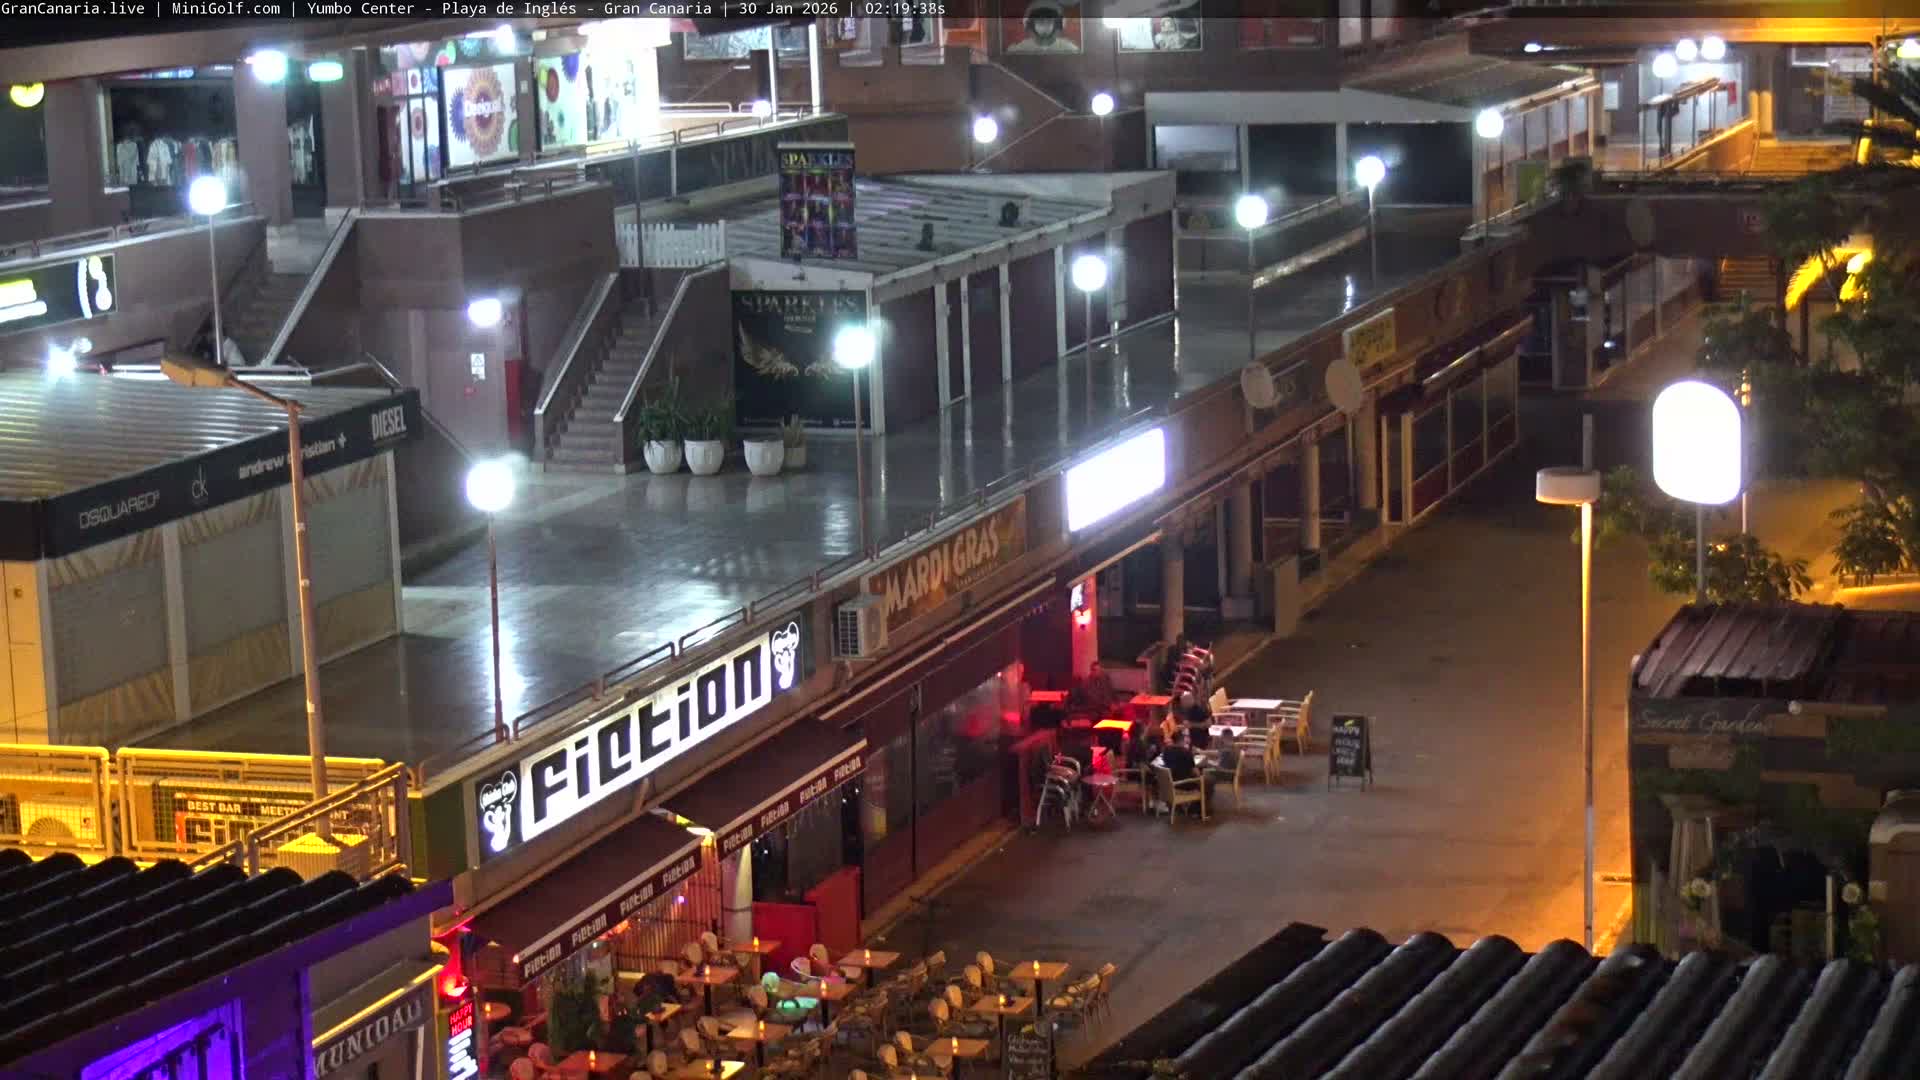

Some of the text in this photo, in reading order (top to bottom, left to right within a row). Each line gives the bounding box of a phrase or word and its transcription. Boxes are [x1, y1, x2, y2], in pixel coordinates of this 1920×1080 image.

[371, 405, 407, 440] DIESEL
[881, 543, 950, 617] MARDI
[952, 514, 1001, 577] GRAS
[187, 801, 216, 812] BEST
[218, 804, 241, 814] BAR
[450, 1002, 473, 1025] HAPPY
[451, 1015, 473, 1037] HOUR
